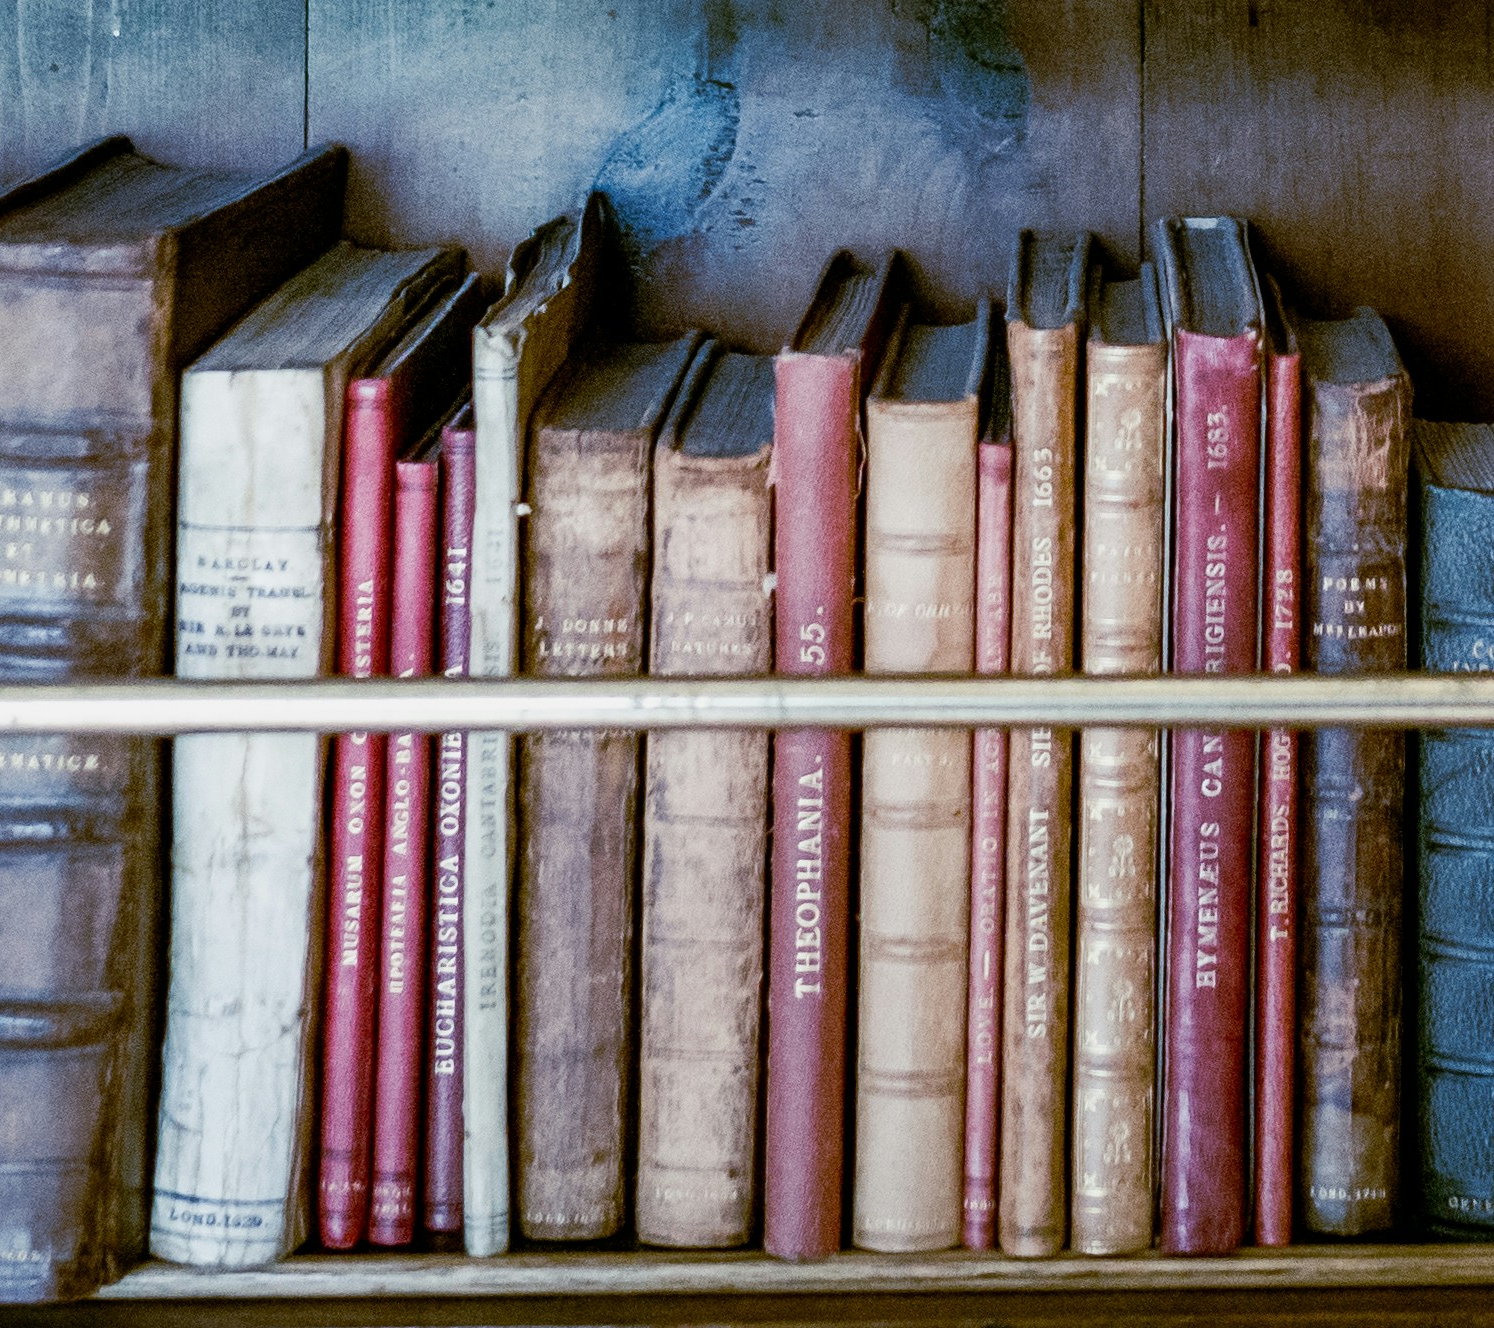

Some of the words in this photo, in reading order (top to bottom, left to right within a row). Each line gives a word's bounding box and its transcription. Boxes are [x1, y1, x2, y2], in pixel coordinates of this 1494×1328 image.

[1032, 446, 1054, 507] 1663
[1032, 536, 1053, 640] RHODES
[1322, 576, 1388, 591] POEMS
[1344, 600, 1365, 614] BY
[346, 765, 368, 834] OXON
[341, 854, 365, 966] MUSARUM
[795, 754, 824, 999] THEOPHANIA.
[1028, 808, 1050, 952] DAVENANT
[1196, 820, 1221, 989] HYMENÆUS
[434, 853, 460, 1076] EUCHARISTICA
[1028, 994, 1048, 1039] SIR
